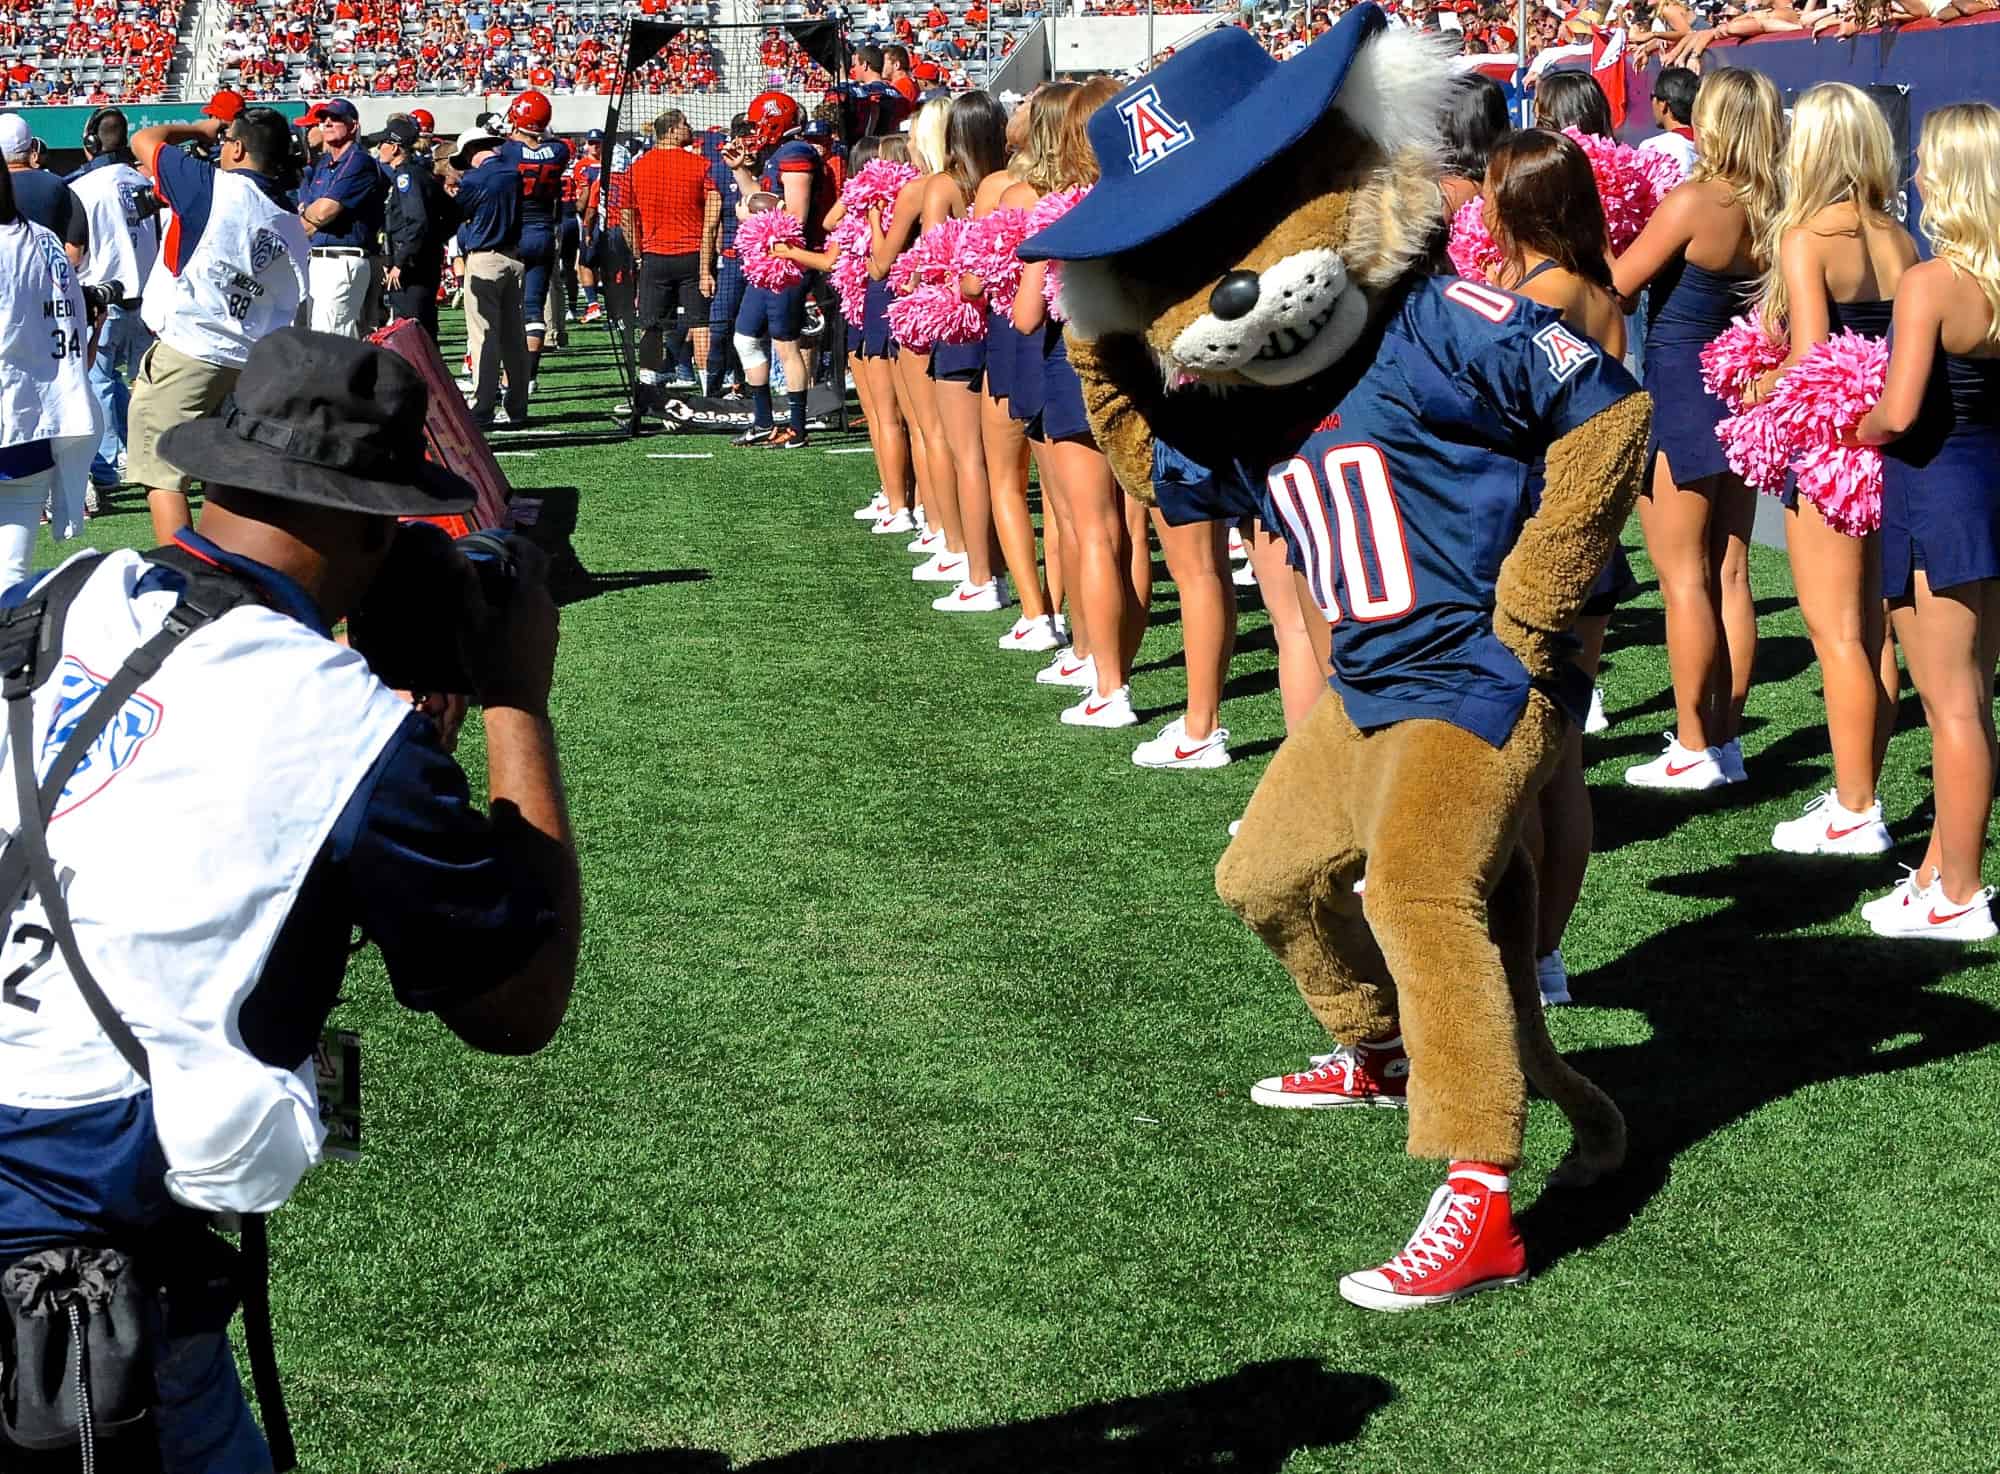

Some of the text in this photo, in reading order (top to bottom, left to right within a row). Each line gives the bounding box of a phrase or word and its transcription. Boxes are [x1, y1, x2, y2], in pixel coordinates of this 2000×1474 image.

[1115, 83, 1195, 175] A
[230, 293, 252, 320] 88
[1445, 280, 1515, 322] 0
[51, 327, 81, 360] 34
[1532, 321, 1598, 383] A
[1267, 442, 1416, 624] 00
[3, 922, 56, 1014] 2
